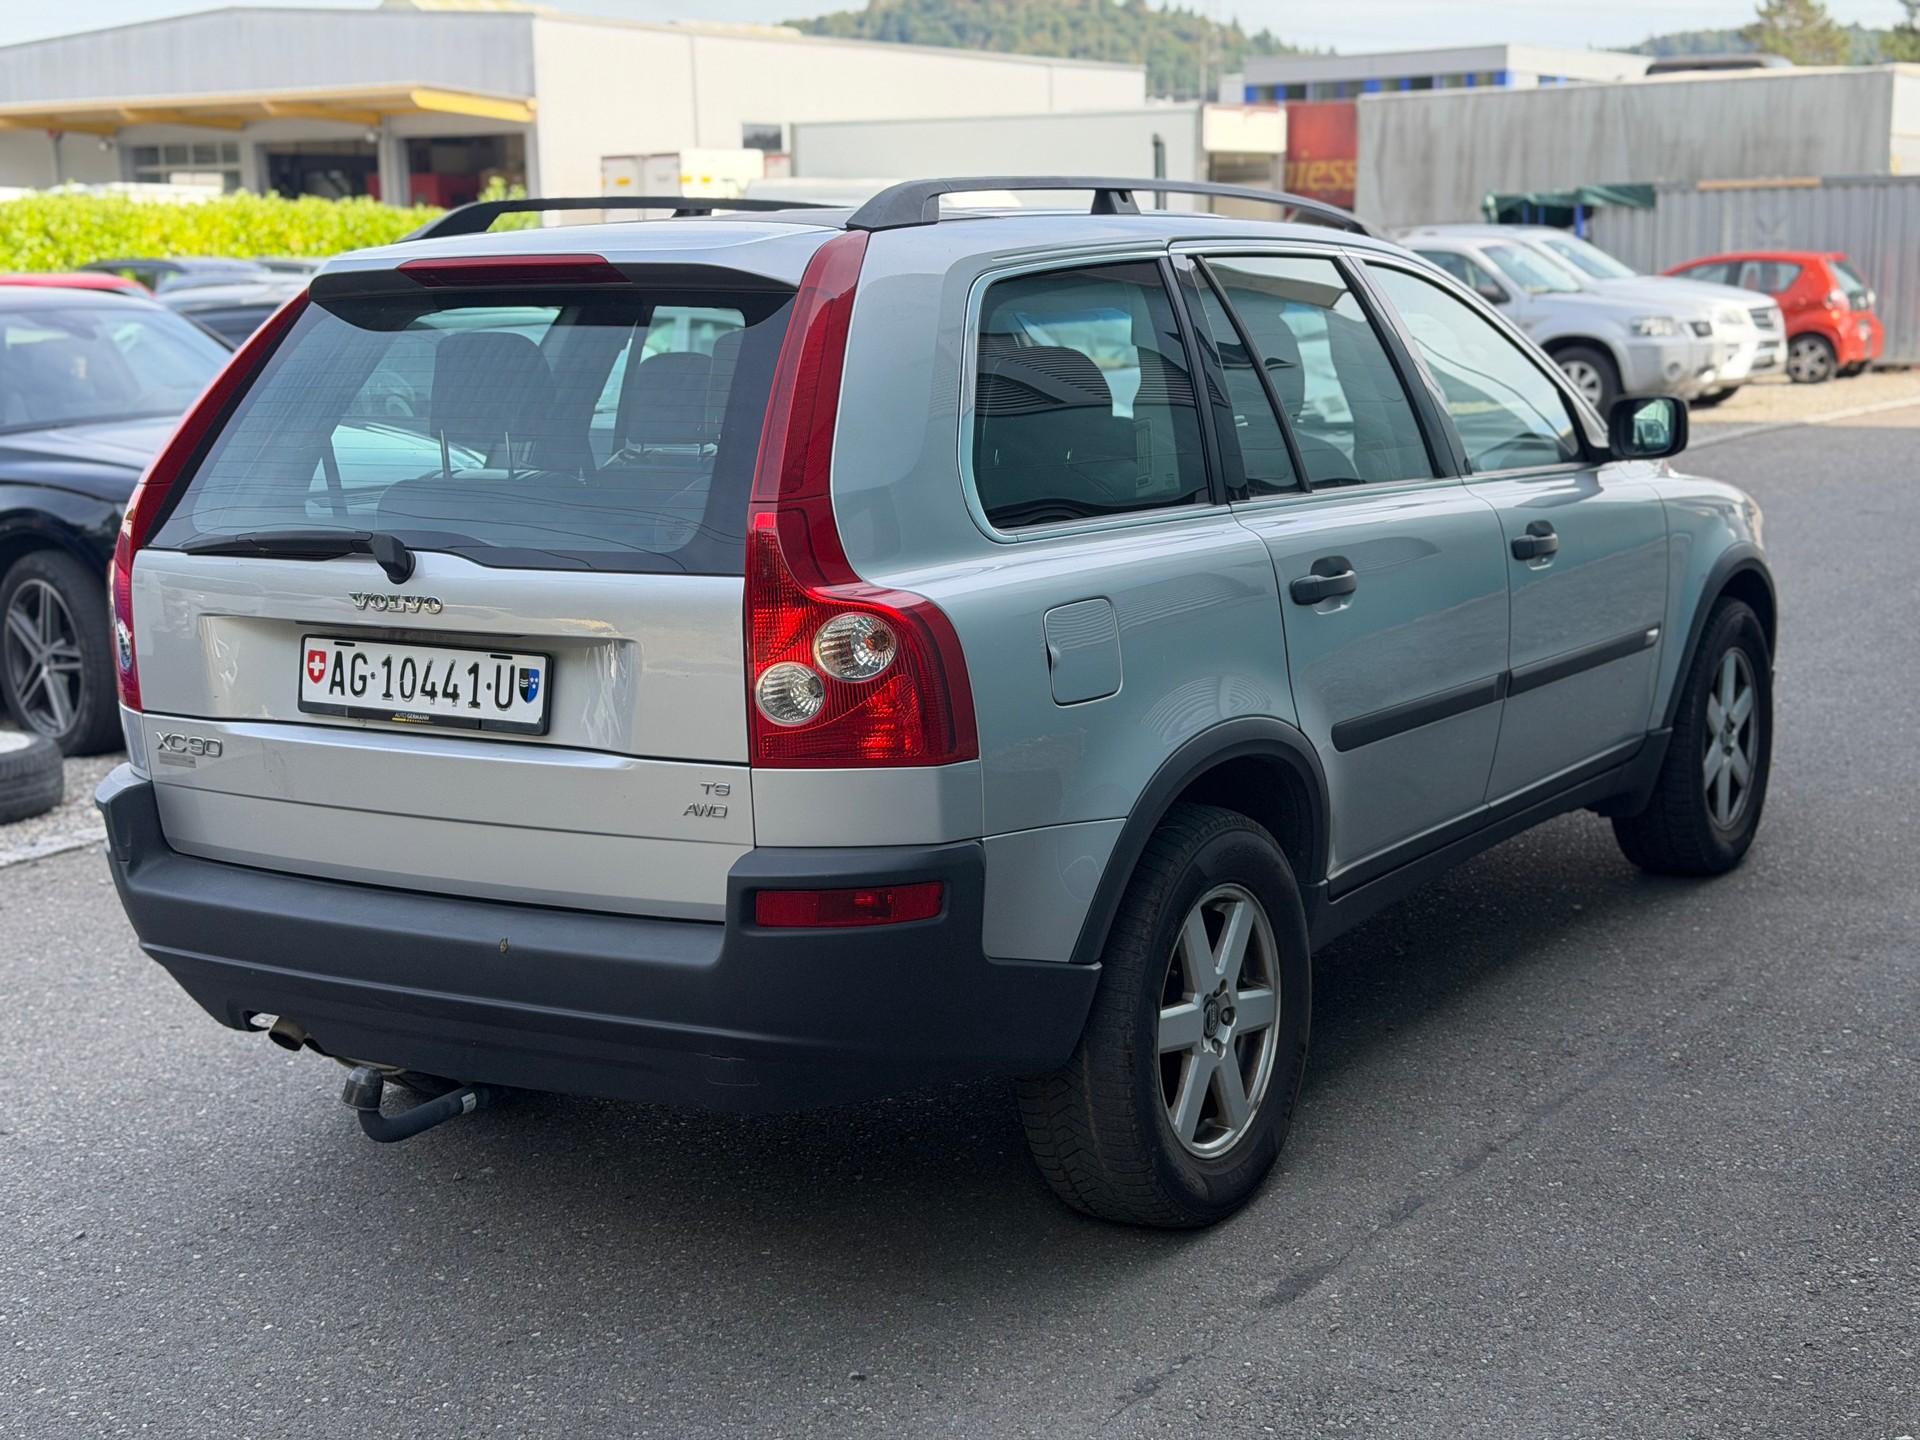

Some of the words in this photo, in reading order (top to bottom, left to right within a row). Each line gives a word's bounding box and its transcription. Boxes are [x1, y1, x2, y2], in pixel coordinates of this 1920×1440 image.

[349, 592, 443, 614] VOLVO
[156, 731, 223, 758] XC90
[683, 803, 728, 819] AWD
